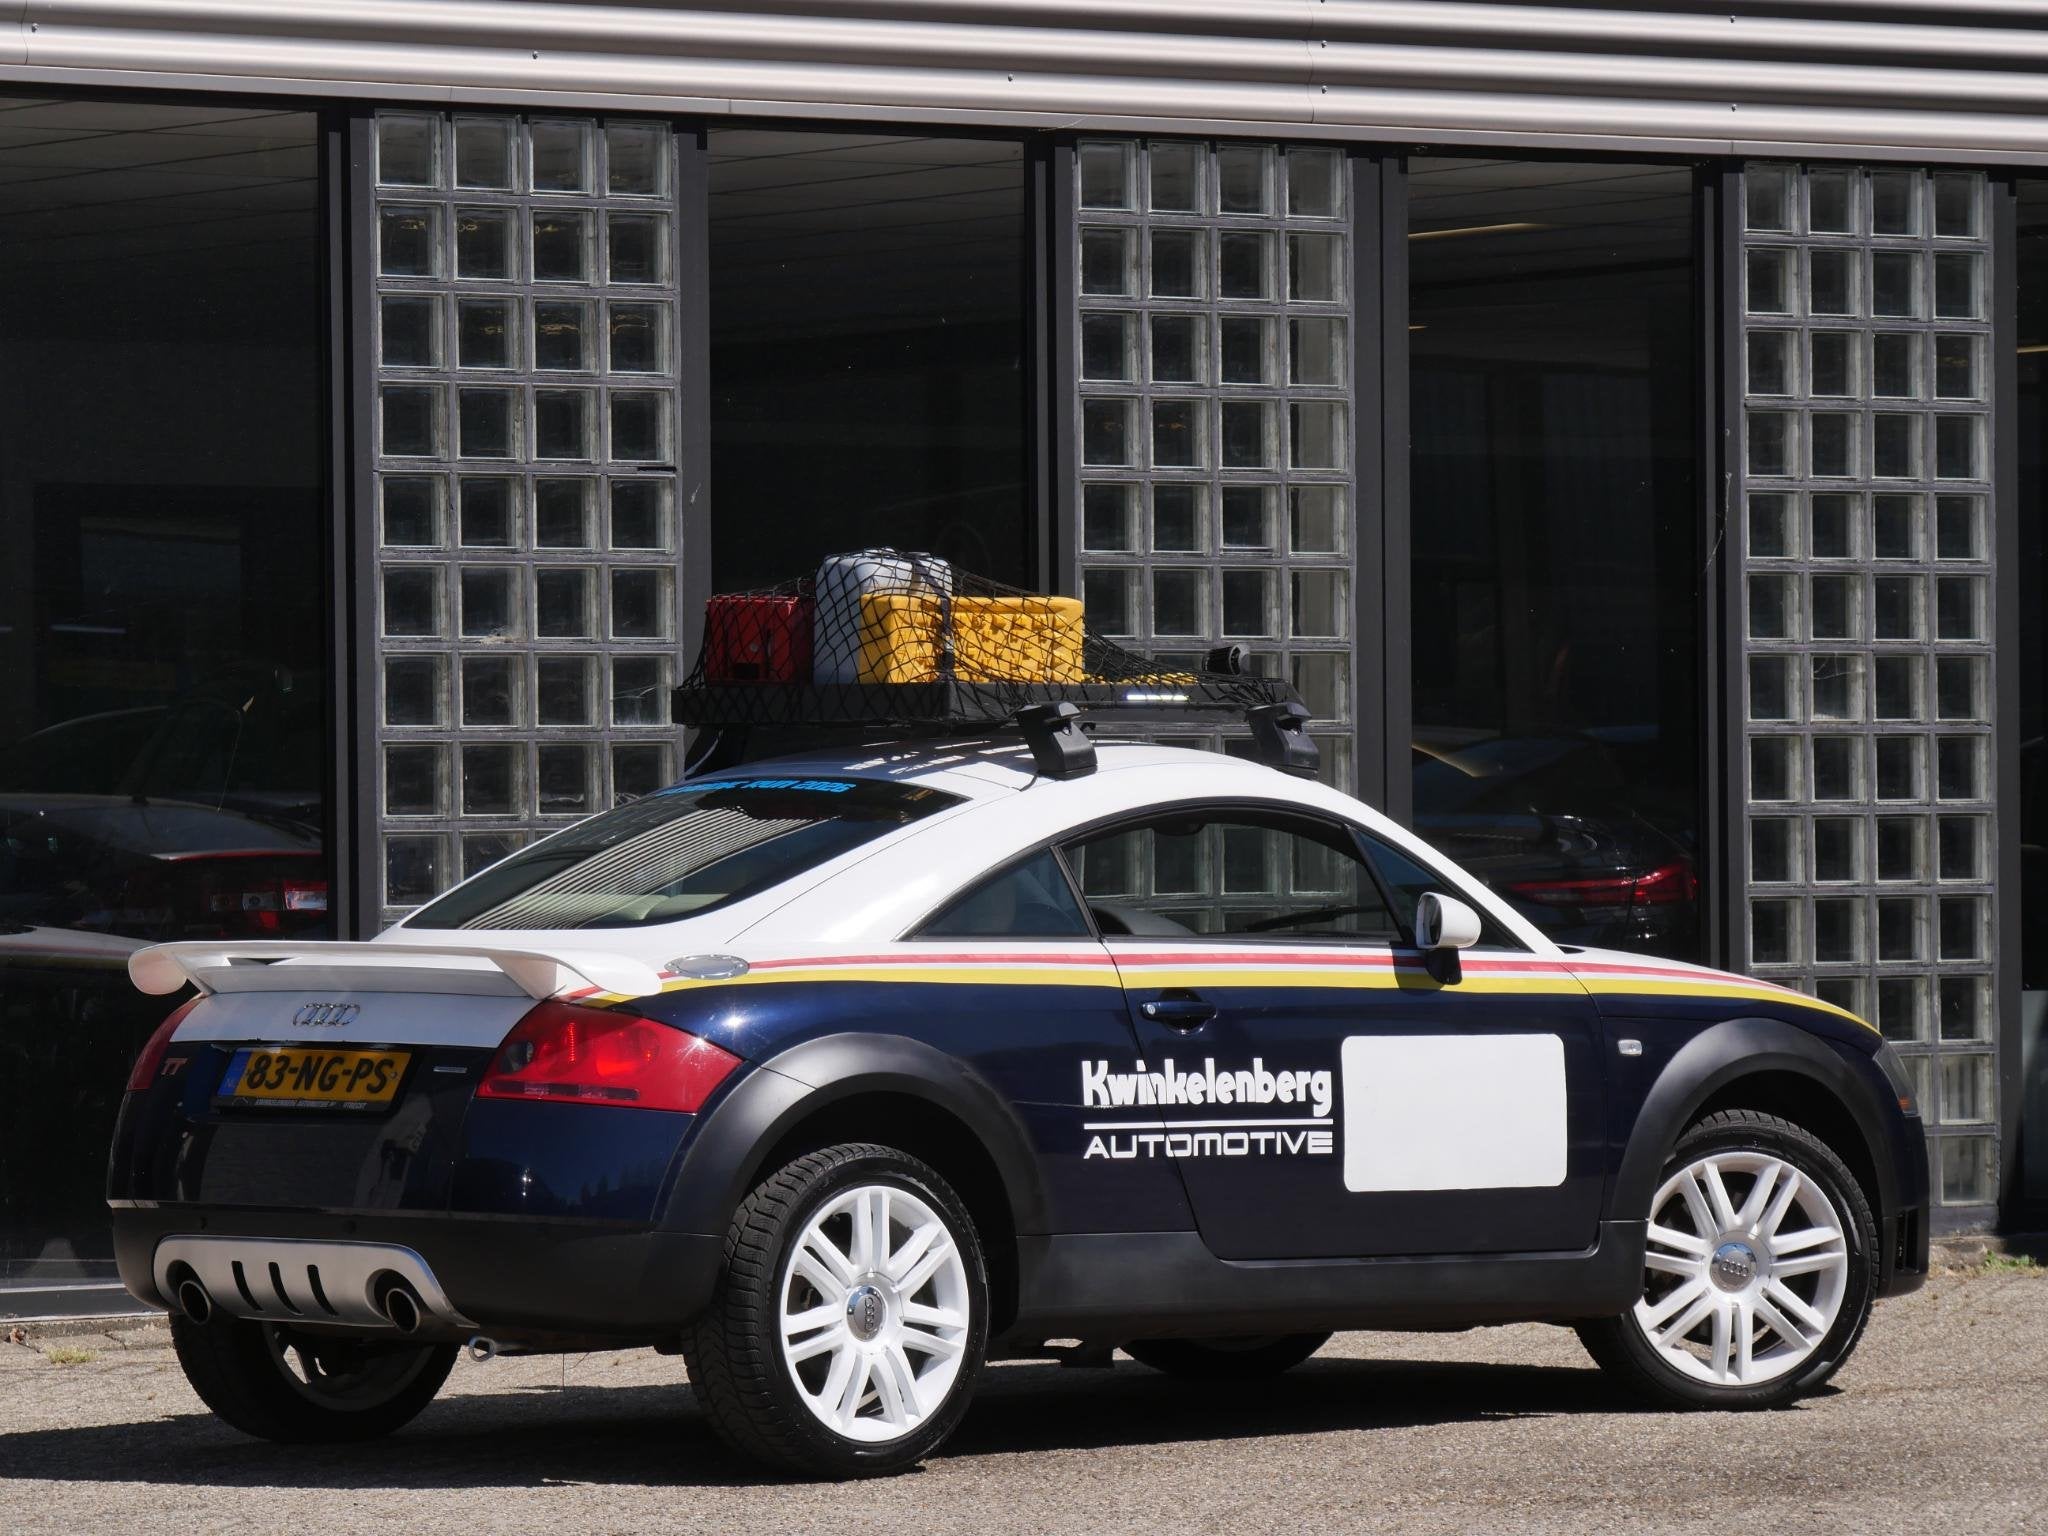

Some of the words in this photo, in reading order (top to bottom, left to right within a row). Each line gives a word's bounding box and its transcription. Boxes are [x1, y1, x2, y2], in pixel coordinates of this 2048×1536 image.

[160, 1057, 188, 1075] TT
[246, 1054, 395, 1094] 83-NG-PS
[1081, 1057, 1333, 1117] Kwinkelenberg
[1083, 1131, 1333, 1159] AUTOMOTIVE
